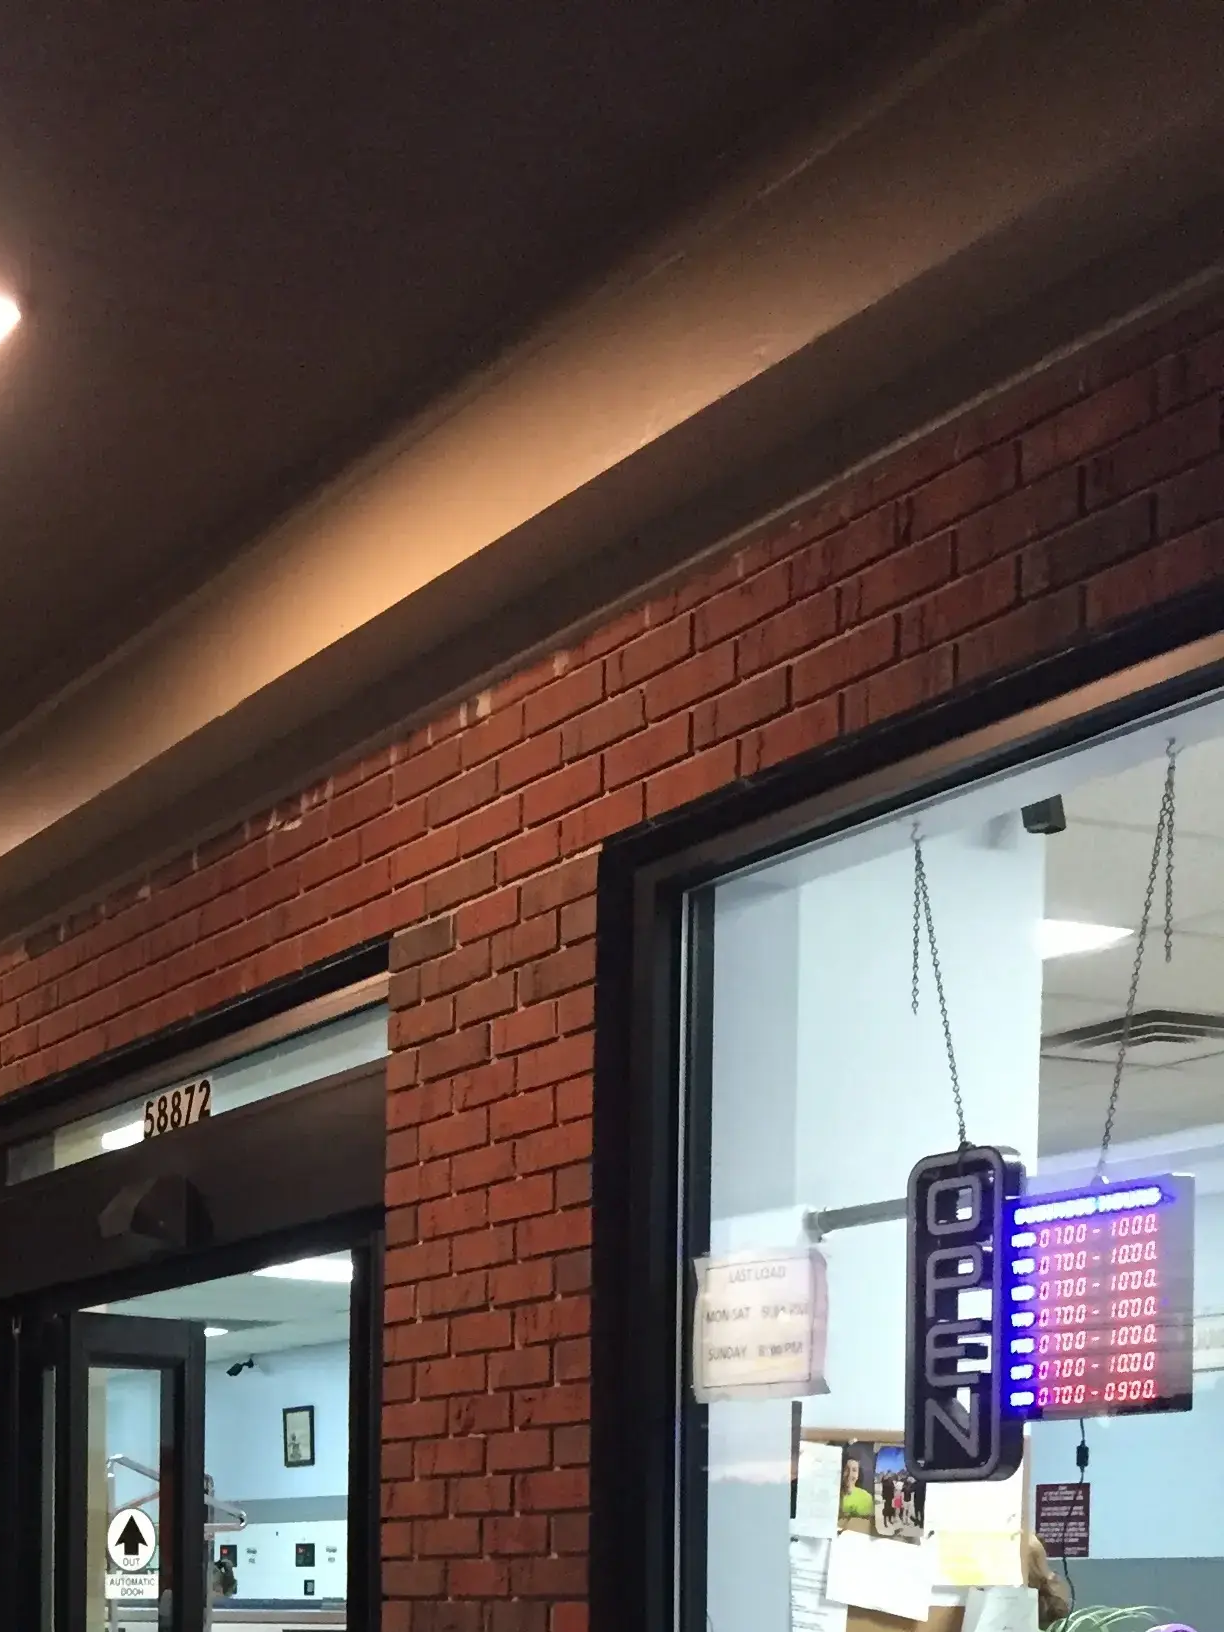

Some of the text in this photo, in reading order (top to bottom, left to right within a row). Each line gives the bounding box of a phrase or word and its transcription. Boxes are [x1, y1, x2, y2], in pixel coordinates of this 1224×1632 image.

[144, 1079, 211, 1139] 58872
[729, 1266, 787, 1283] LAST LOAD
[926, 1174, 984, 1463] OPEN
[708, 1345, 748, 1361] SUNDAY
[122, 1558, 140, 1567] OUT
[109, 1578, 156, 1587] AUTOMATIC
